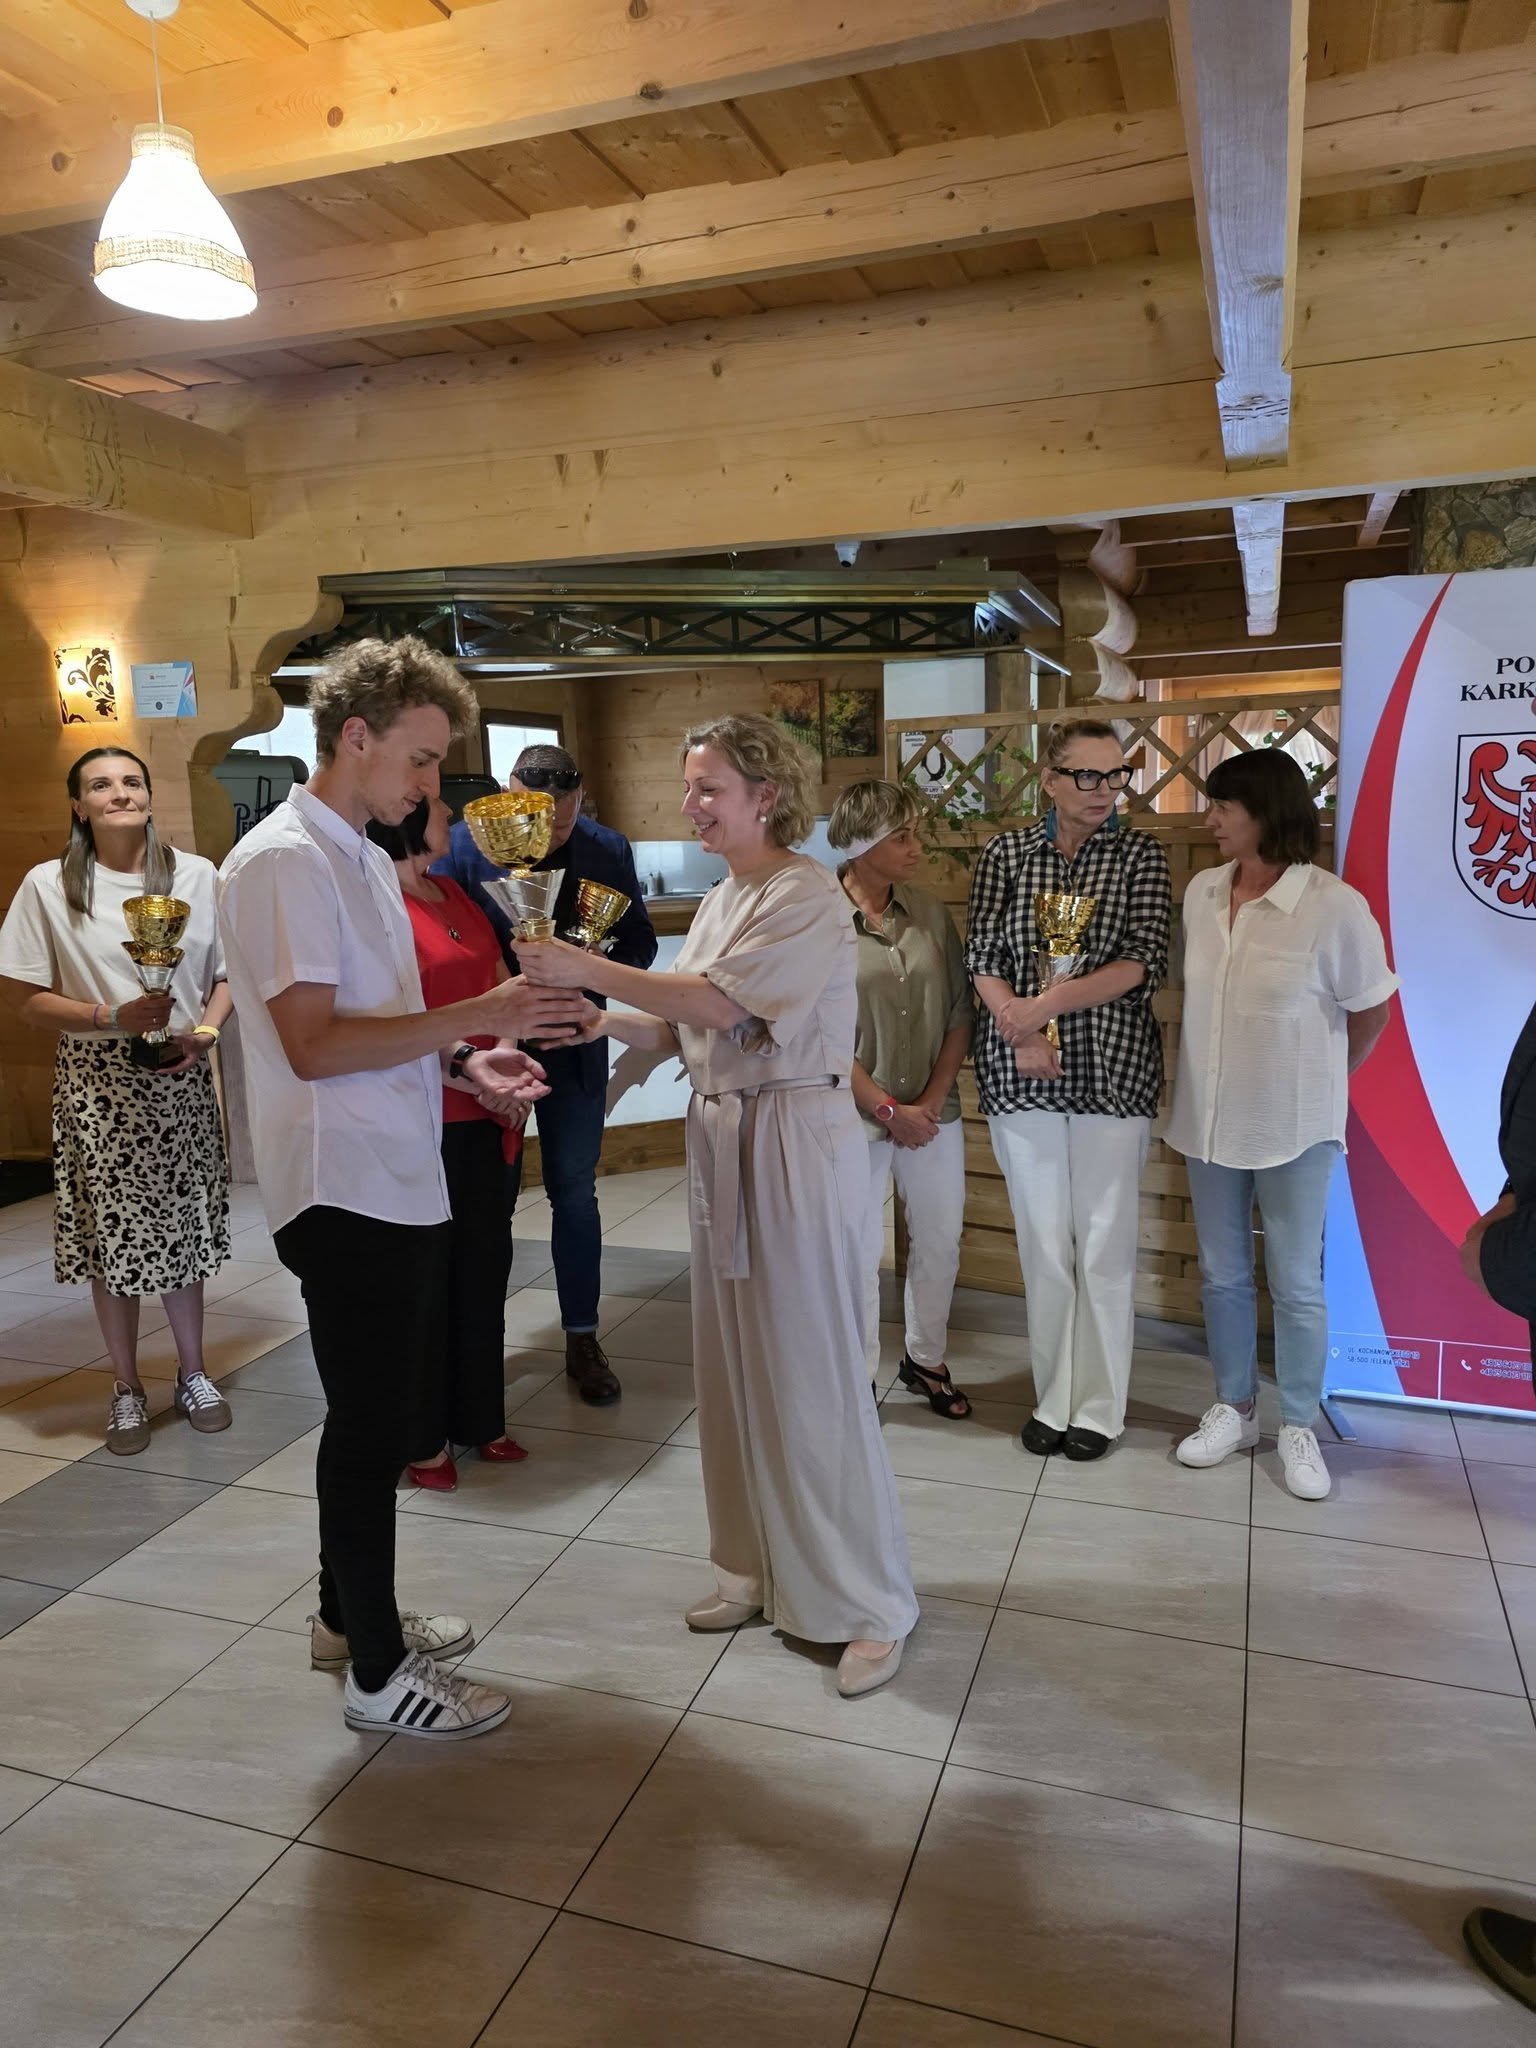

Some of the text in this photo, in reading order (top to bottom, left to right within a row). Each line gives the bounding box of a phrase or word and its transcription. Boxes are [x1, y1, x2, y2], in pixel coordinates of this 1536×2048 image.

[1496, 656, 1536, 675] PO
[1460, 681, 1536, 702] KARK
[1347, 1355, 1368, 1363] 58-500
